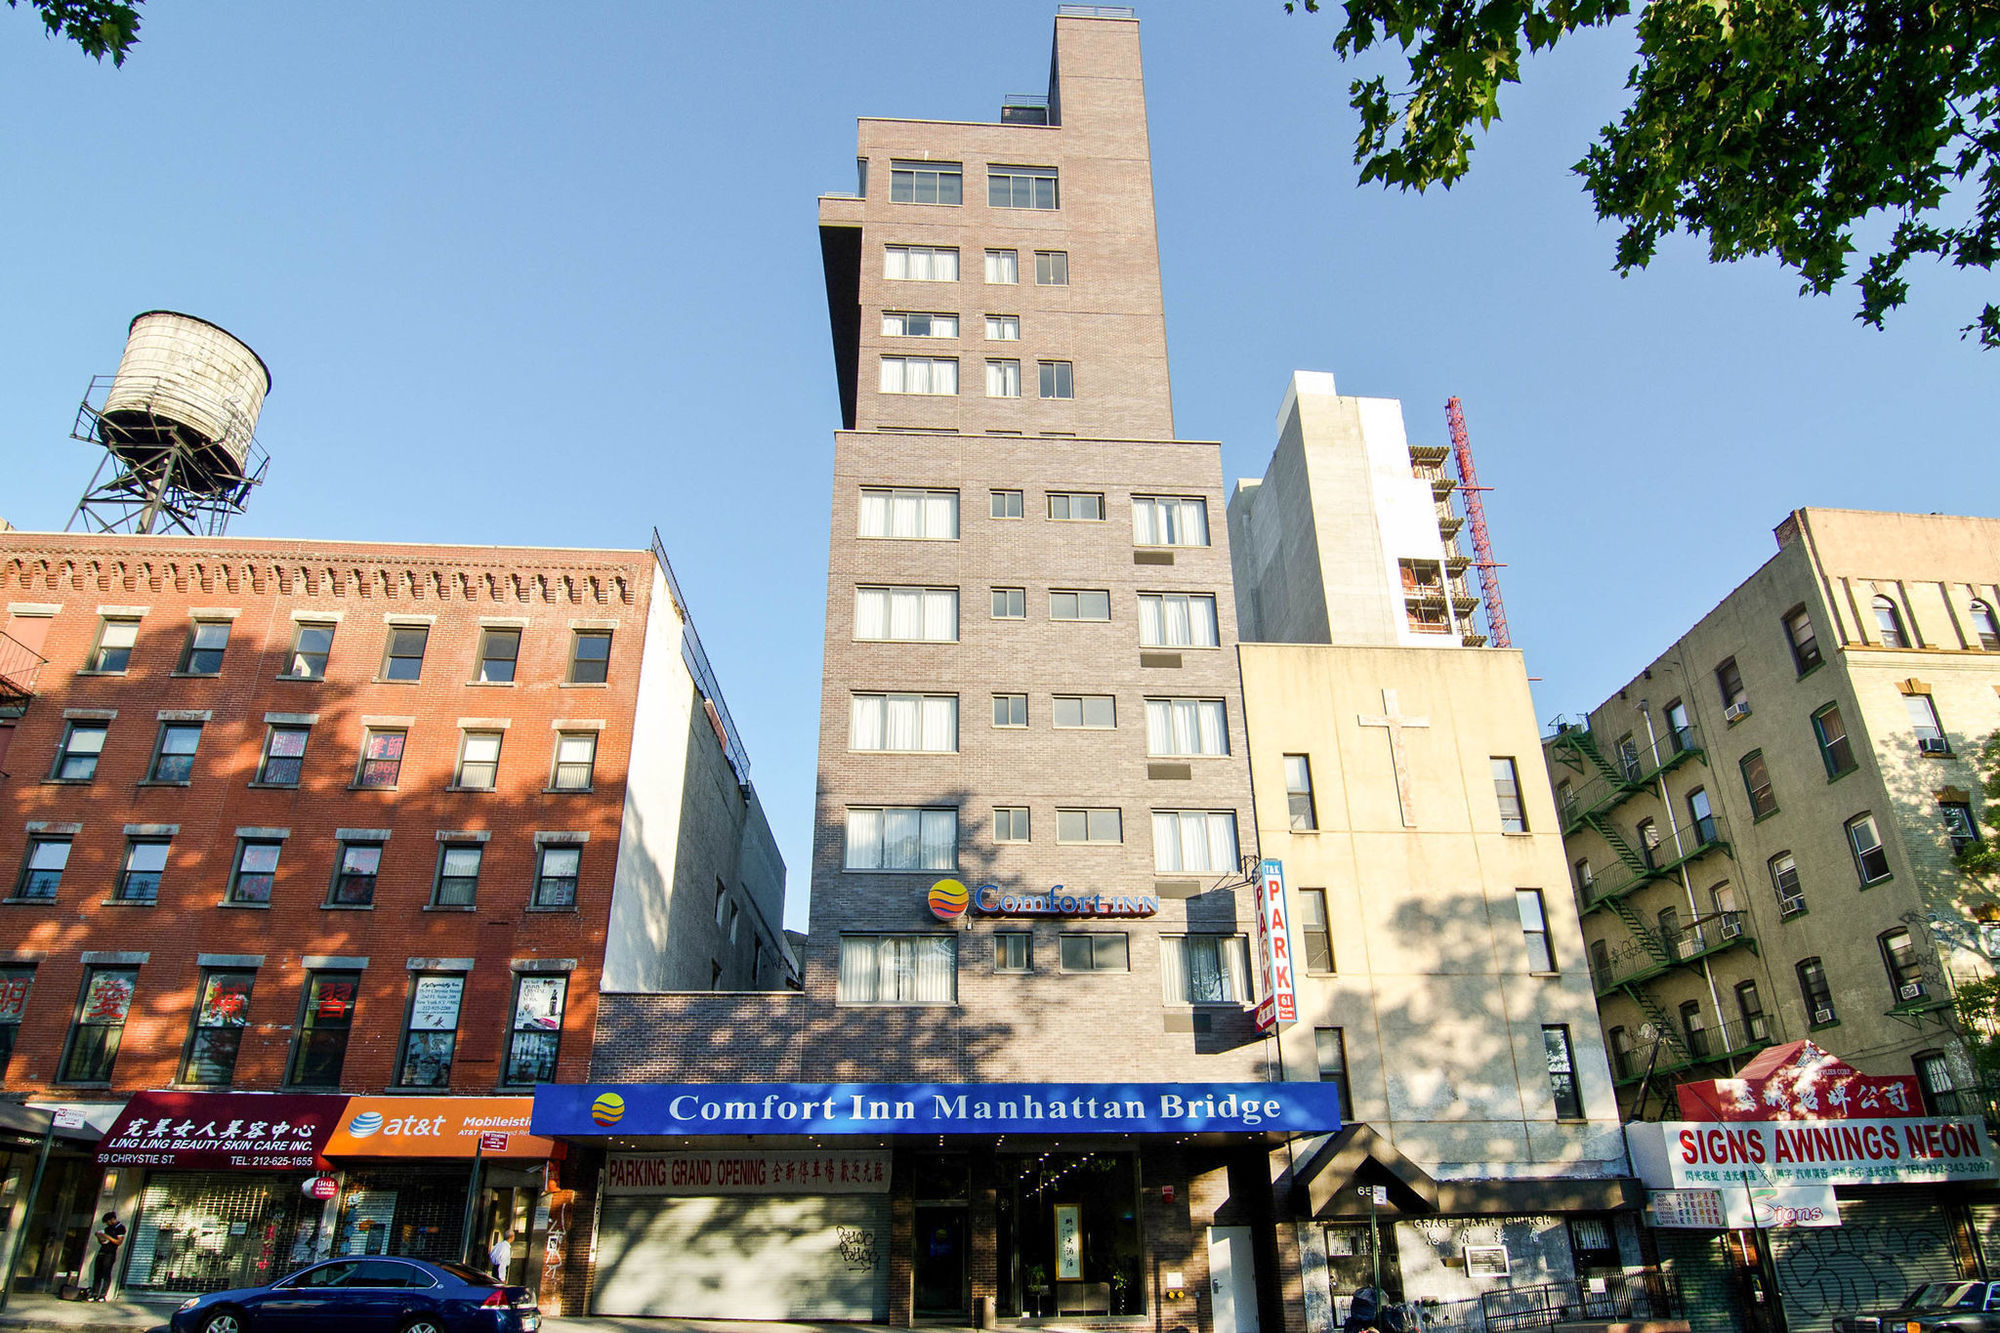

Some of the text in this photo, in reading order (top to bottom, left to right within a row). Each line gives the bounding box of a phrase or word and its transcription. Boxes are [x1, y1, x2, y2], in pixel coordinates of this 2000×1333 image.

[975, 884, 1160, 912] Comfort INN
[1256, 884, 1272, 994] PARK
[1268, 880, 1291, 989] PARK
[318, 983, 351, 1019] 習
[1281, 995, 1291, 1005] 61
[669, 1094, 1281, 1125] Comfort Inn Manhattan Bridge
[383, 1115, 446, 1136] at&t
[108, 1138, 313, 1151] LING LING BEAUTY SKIN CARE INC.
[1679, 1123, 1981, 1164] SIGNS AWNINGS NEON
[97, 1153, 175, 1164] 59 CHRYSTIE ST.
[230, 1156, 313, 1166] TEL: 212-625-1655
[609, 1159, 766, 1187] PARKING GRAND OPENING
[1414, 1218, 1454, 1229] GRACE
[1505, 1215, 1551, 1226] CHURCH
